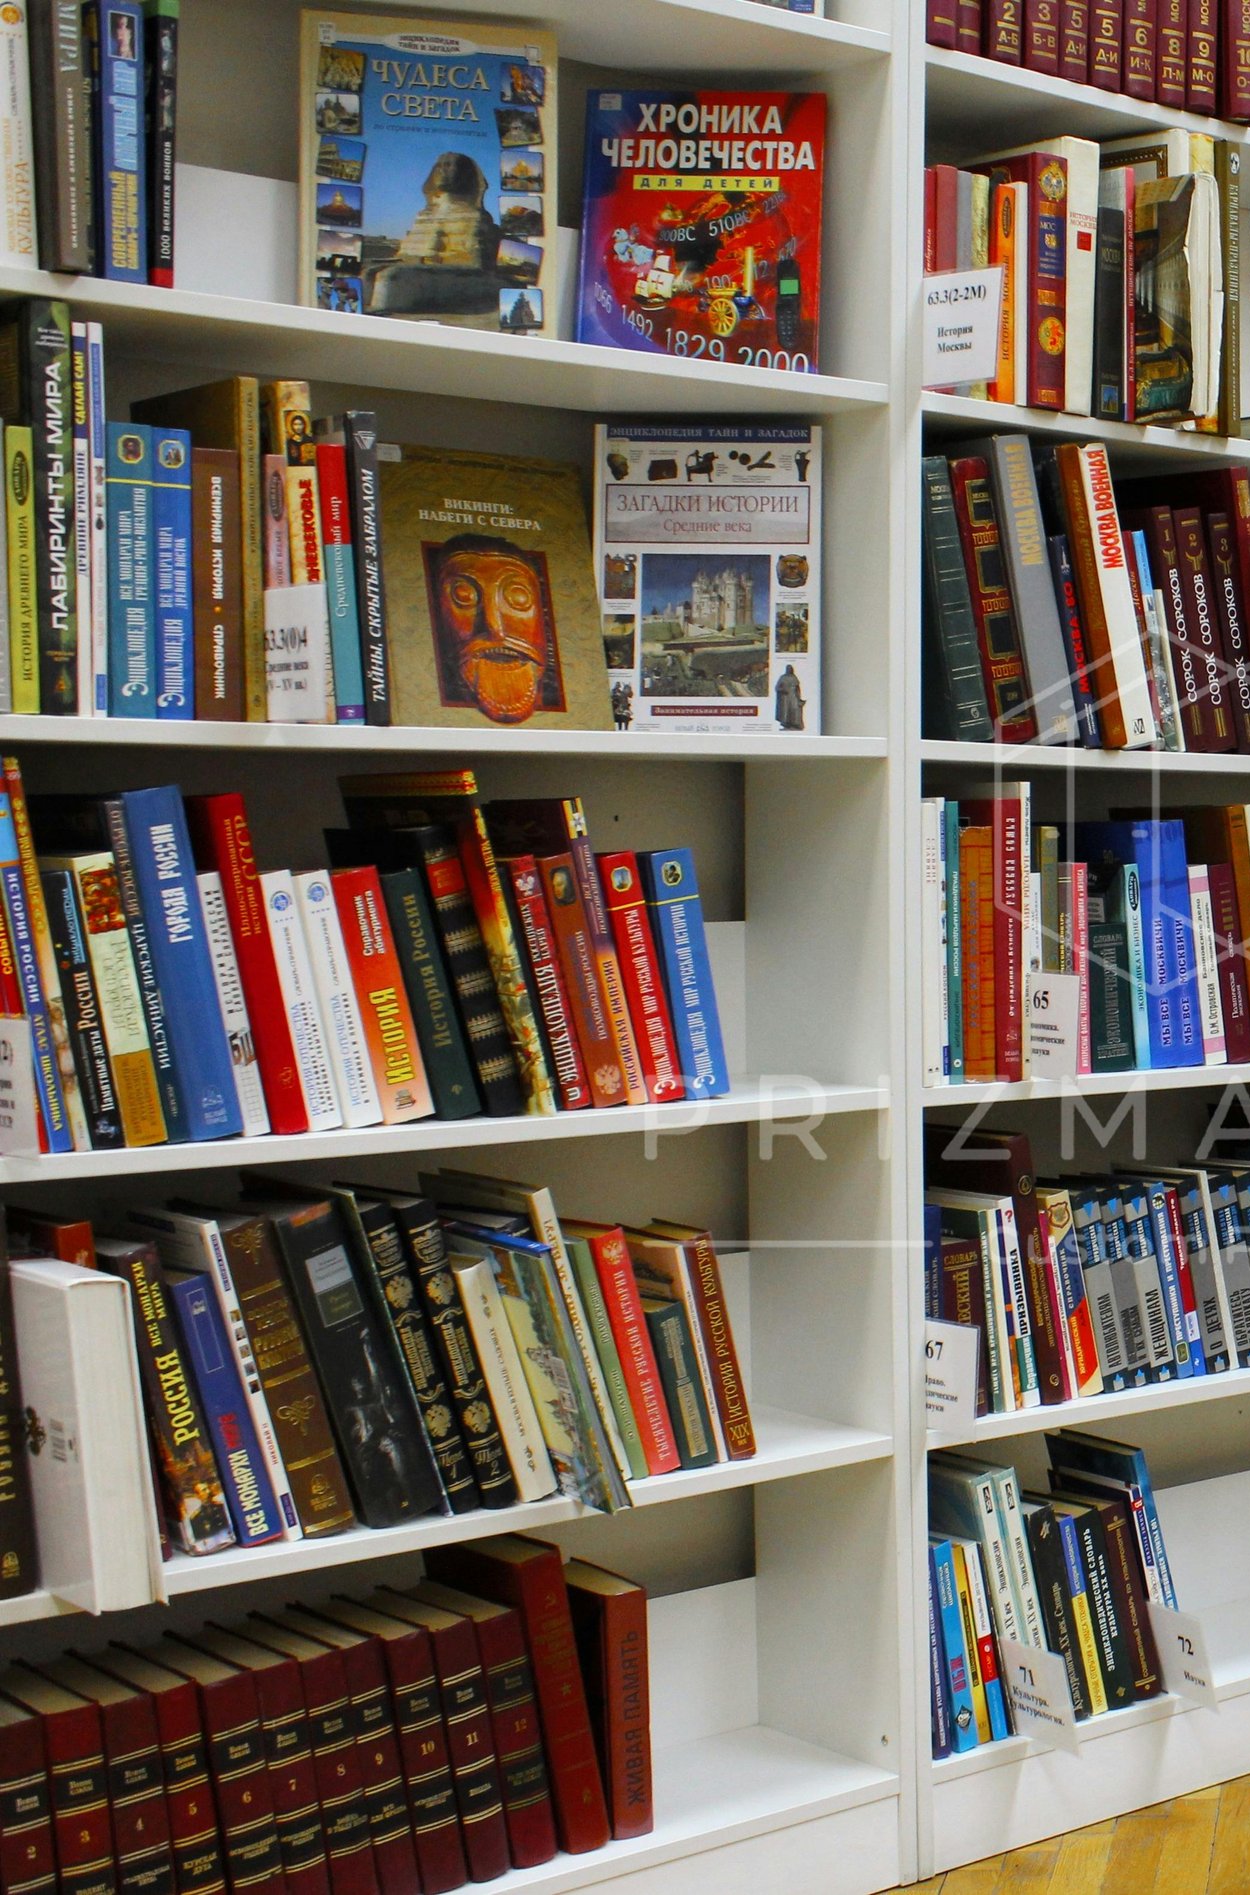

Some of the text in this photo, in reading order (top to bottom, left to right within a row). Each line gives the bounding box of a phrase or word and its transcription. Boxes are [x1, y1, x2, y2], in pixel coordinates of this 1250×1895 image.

[1003, 2, 1017, 20] 2
[1038, 3, 1051, 20] 3
[1101, 16, 1114, 37] 5
[998, 30, 1019, 46] А-Б
[1032, 31, 1056, 47] Б-В
[1135, 27, 1148, 46] 6
[1199, 40, 1210, 58] 9
[371, 59, 490, 91] ЧУДЕСА
[1095, 48, 1119, 64] Д-И
[1130, 56, 1152, 72] И-К
[1192, 68, 1214, 84] М-О
[381, 93, 480, 122] СВЕТА
[637, 103, 782, 135] ХРОНИКА
[601, 139, 815, 171] ЧЕЛОВЕЧЕСТВА
[640, 177, 774, 189] ДЛЯ ДЕТЕЙ
[621, 304, 655, 341] 1492
[937, 325, 973, 338] История
[937, 342, 972, 353] Москвы
[45, 362, 63, 455] МИРА
[610, 426, 809, 439] ЭНЦИКЛОПЕДИЯ ТАЙН И ЗАГАДОК
[1086, 449, 1117, 511] ВОЕННАЯ
[361, 468, 377, 560] ЗАБРАЛОМ
[418, 508, 541, 532] НАБЕГИ С СЕВЕРА
[444, 497, 514, 517] ВИКИНГИ:
[616, 494, 799, 514] ЗАГАДКИ ИСТОРИИ
[210, 476, 224, 600] ВСЕМИРНАЯ ИСТОРИЯ
[663, 518, 752, 534] Средние века
[1095, 511, 1124, 569] МОСКВА
[50, 461, 69, 632] ЛАБИРИНТЫ
[19, 516, 32, 682] ИСТОРИЯ ДРЕВНЕГО МИРА
[367, 565, 382, 637] СКРЫТЫЕ
[1169, 568, 1197, 702] СОРОК СОРОКОВ
[1194, 574, 1222, 704] СОРОК СОРОКОВ
[1224, 578, 1250, 709] СОРОК СОРОКОВ
[653, 706, 754, 716] Занимательная история
[150, 823, 194, 945] ГОРОДА РОССИИ
[353, 895, 376, 957] Справочник
[364, 890, 385, 955] абитуриента
[1178, 919, 1188, 984] МОСКВИЧИ
[134, 923, 172, 1069] ЦАРСКИЕ ДИНАСТИИ
[1033, 991, 1049, 1009] 65
[369, 987, 416, 1086] ИСТОРИЯ
[534, 962, 579, 1084] ЭНЦИКЛОПЕДИЯ
[602, 960, 639, 1091] РОССИЙСКАЯ ИМПЕРИЯ
[1183, 1022, 1192, 1044] МЫ
[687, 1012, 715, 1089] ЭНЦИКЛОПЕДИЯ
[34, 1014, 63, 1131] АТЛАС ШКОЛЬНИКА
[1010, 1249, 1027, 1334] ПРИЗЫВНИКА
[697, 1238, 740, 1416] ИСТОРИЯ РУССКОЙ КУЛЬТУРЫ
[1098, 1293, 1121, 1368] АВТОЛЮБИТЕЛЯМ
[1146, 1288, 1168, 1362] ЖЕНЩИНАМ
[1168, 1285, 1182, 1341] ПРЕСТУПНИКИ
[1204, 1297, 1221, 1335] ДЕТЯХ
[926, 1340, 943, 1360] 67
[154, 1349, 199, 1446] РОССИЯ
[229, 1450, 259, 1510] МОНАРХИ
[1083, 1529, 1095, 1572] СЛОВАРЬ
[1178, 1636, 1194, 1655] 72
[622, 1631, 638, 1722] ПАМЯТЬ
[1019, 1666, 1034, 1686] 71
[1184, 1671, 1206, 1687] Наука
